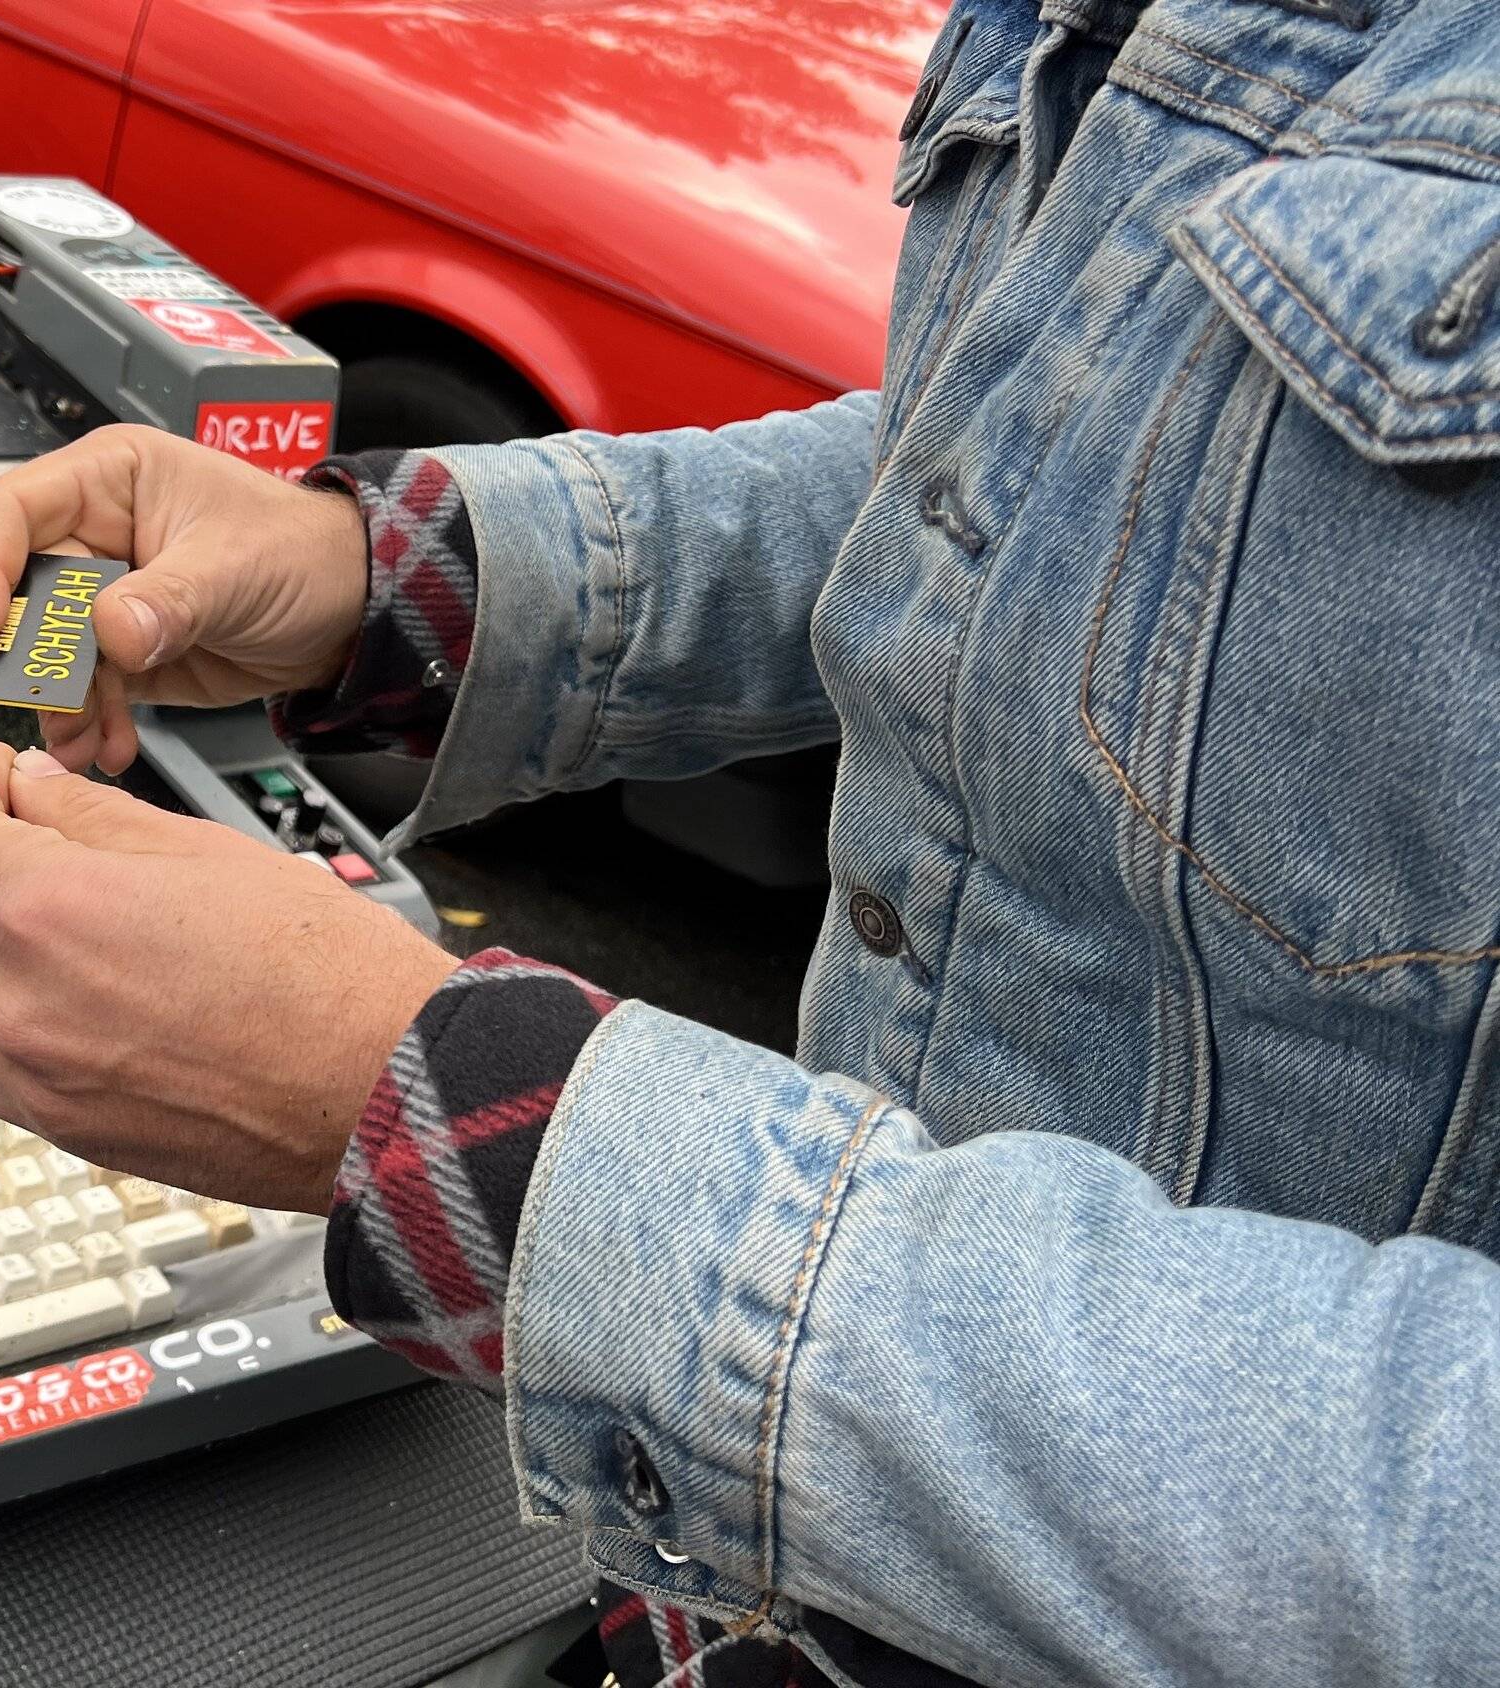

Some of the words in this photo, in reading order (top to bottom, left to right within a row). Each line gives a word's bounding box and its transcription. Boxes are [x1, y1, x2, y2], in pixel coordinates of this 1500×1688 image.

[202, 410, 324, 454] DRIVE
[23, 568, 102, 680] SCHYEAH
[150, 1318, 272, 1370] CO.
[81, 1354, 148, 1390] CO.
